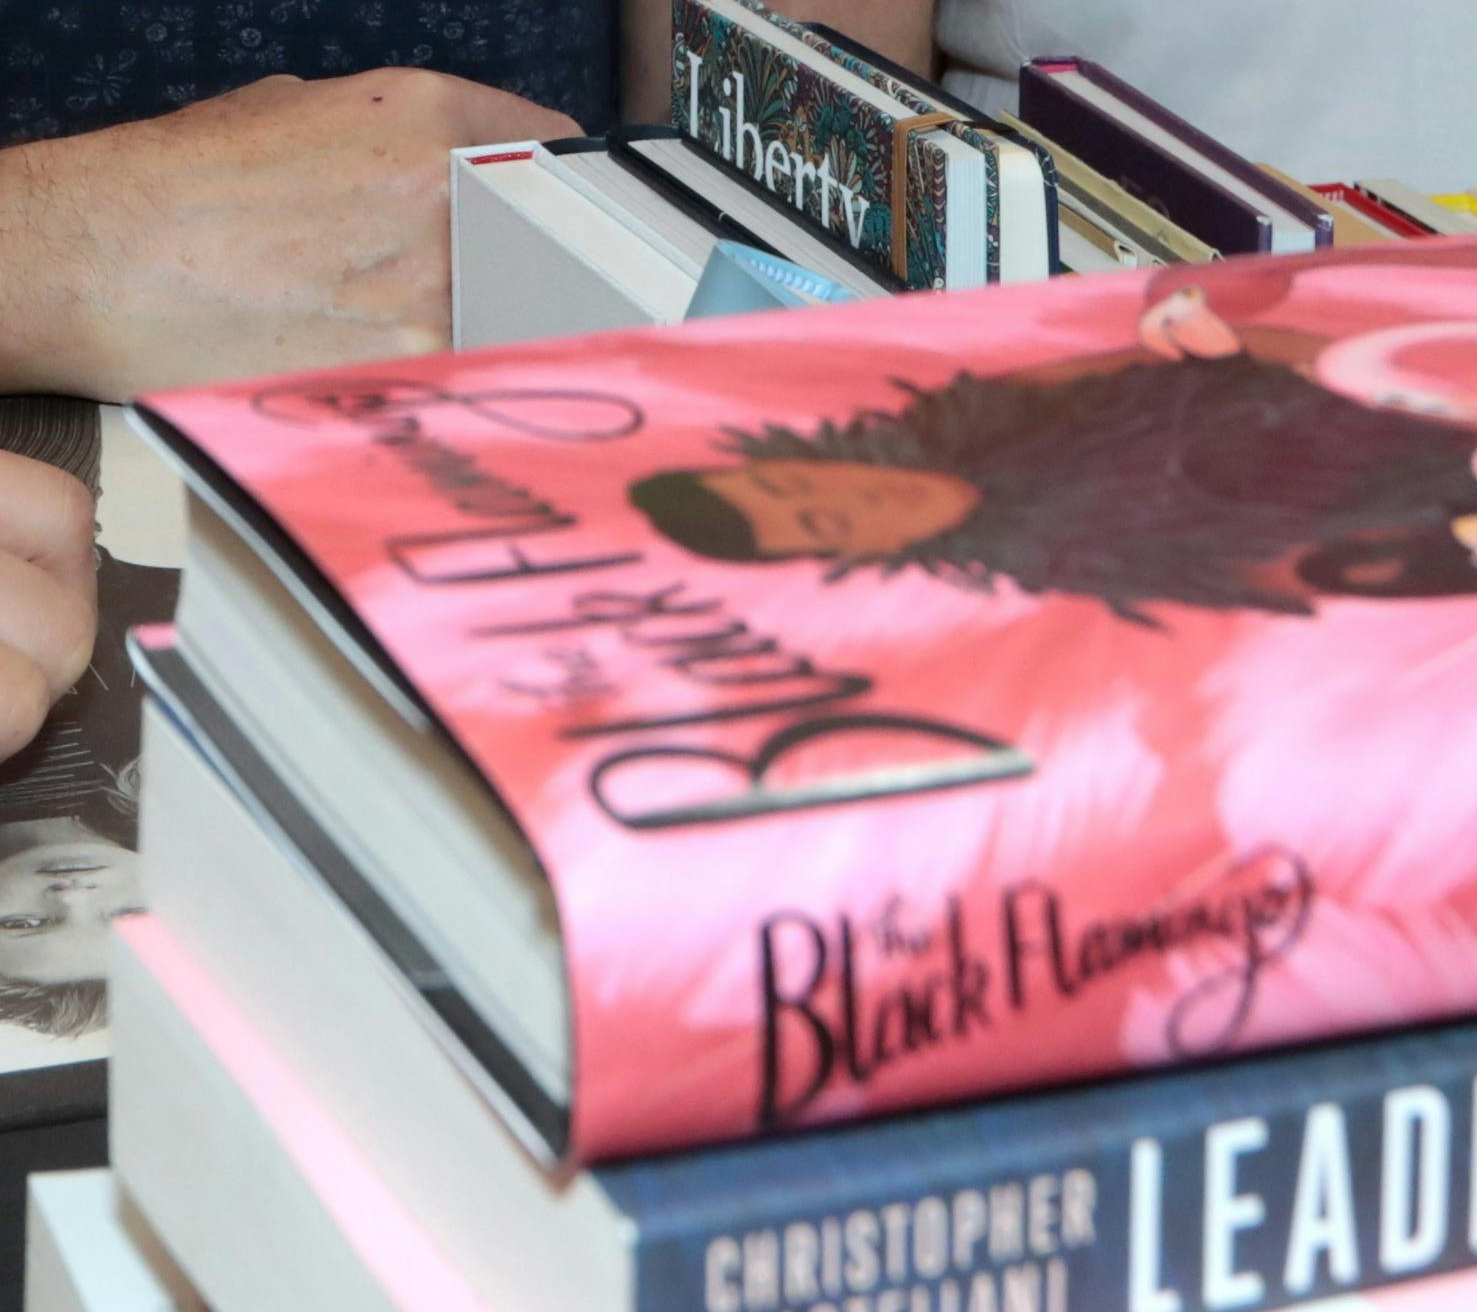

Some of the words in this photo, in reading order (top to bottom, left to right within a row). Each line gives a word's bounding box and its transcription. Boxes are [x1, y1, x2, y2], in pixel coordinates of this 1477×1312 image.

[684, 48, 872, 251] Liberty
[754, 905, 998, 1133] Black
[997, 841, 1318, 1055] Flamingo
[703, 1165, 1100, 1312] CHRISTOPHER
